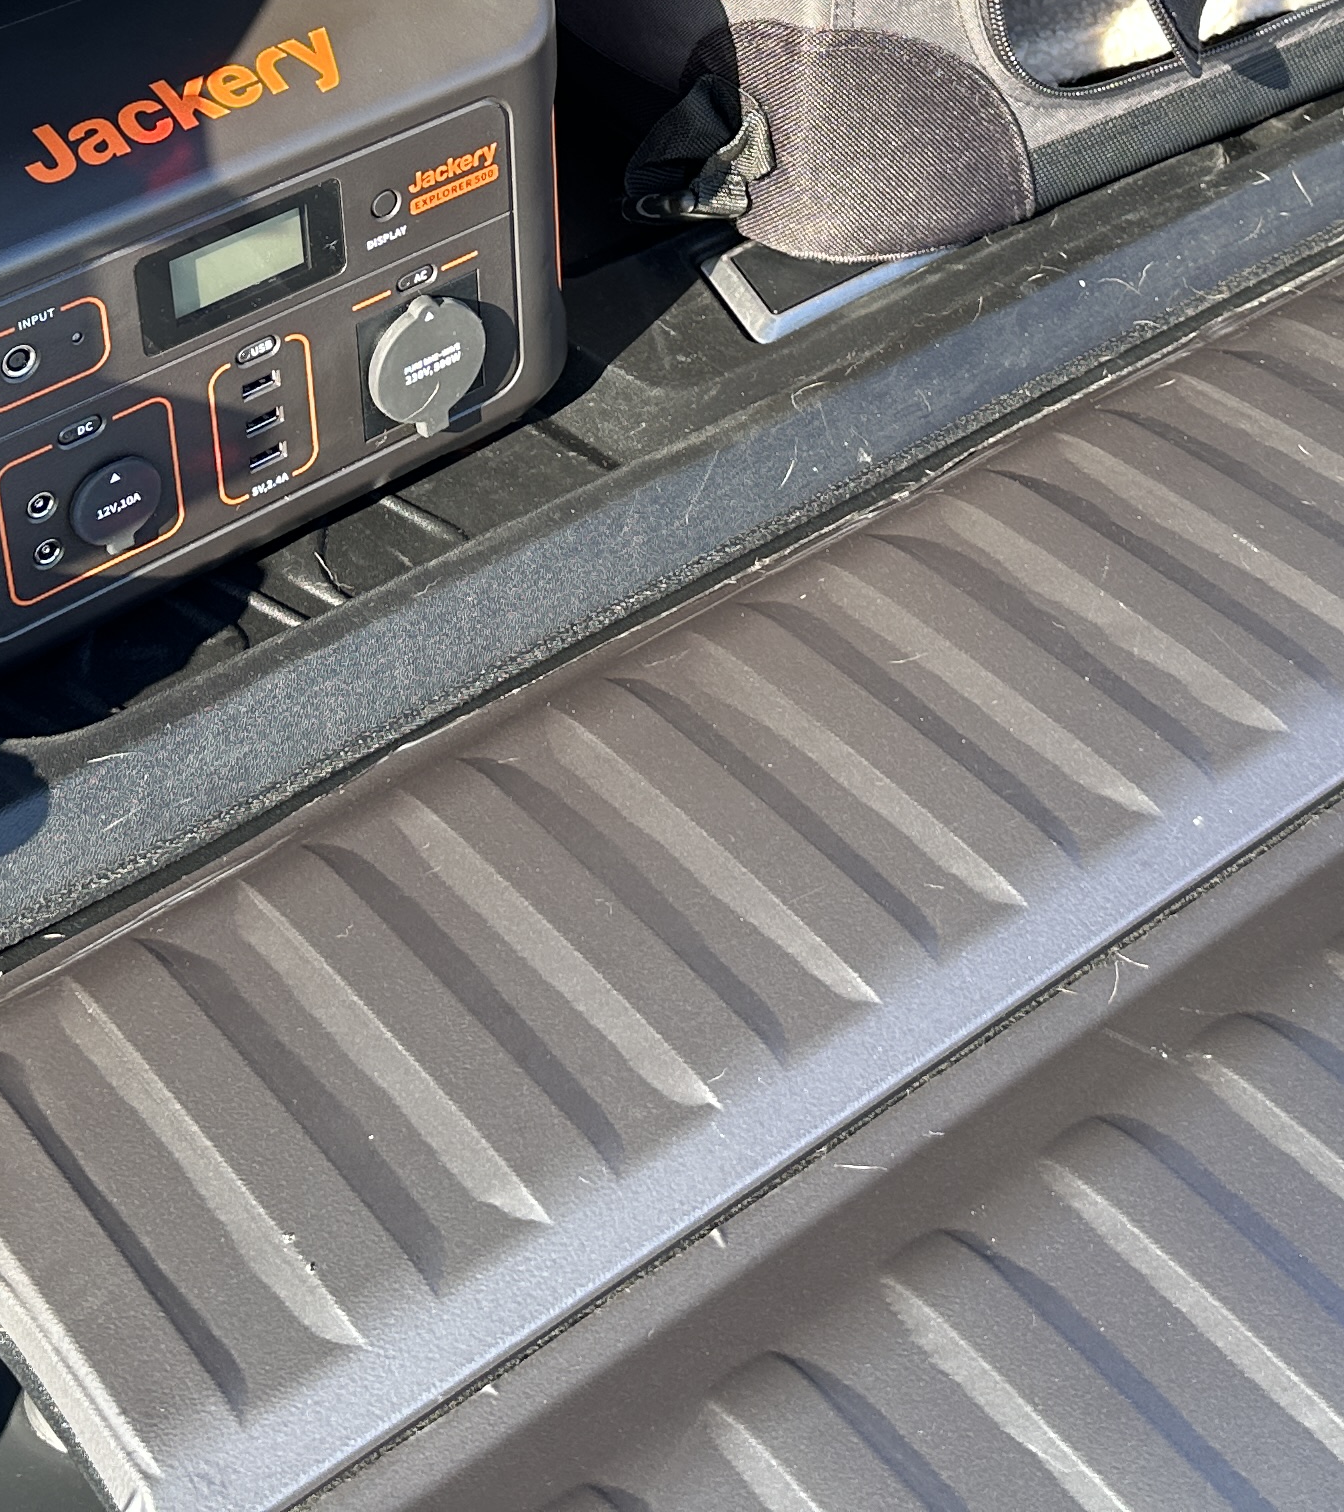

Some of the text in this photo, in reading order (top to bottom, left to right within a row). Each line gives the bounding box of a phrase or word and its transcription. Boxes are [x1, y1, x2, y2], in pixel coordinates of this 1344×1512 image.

[23, 26, 341, 185] Jackery
[408, 141, 498, 194] Jackery
[414, 169, 494, 210] EXPLORER 500
[366, 224, 408, 251] DISPLAY
[414, 270, 428, 284] AC
[17, 307, 56, 331] INPUT
[249, 339, 273, 357] USB
[76, 421, 94, 437] DC
[96, 492, 142, 521] 12V,10A
